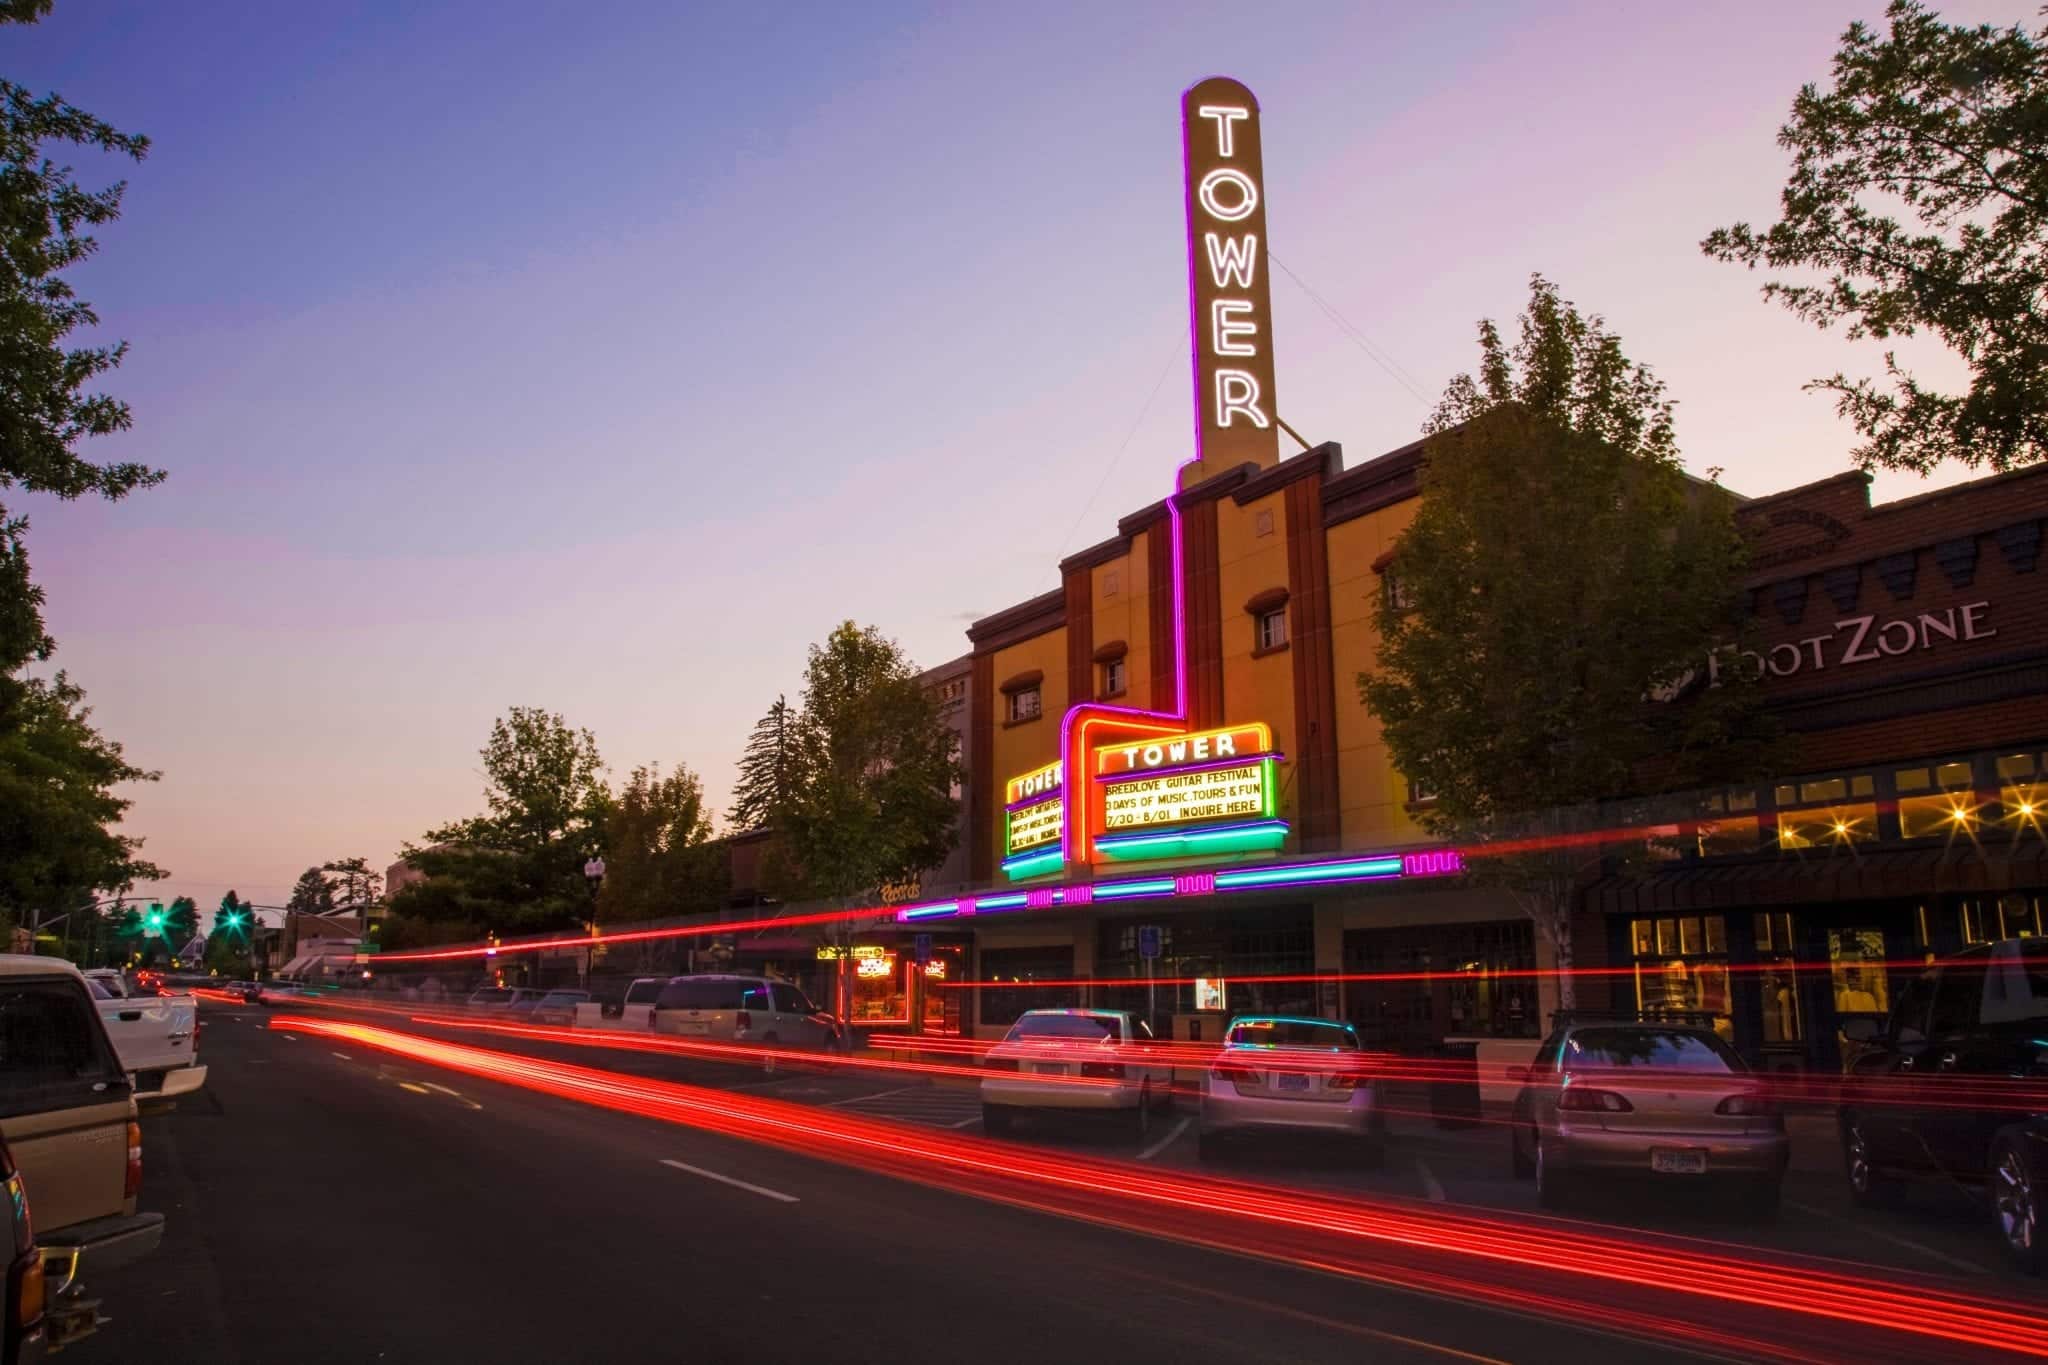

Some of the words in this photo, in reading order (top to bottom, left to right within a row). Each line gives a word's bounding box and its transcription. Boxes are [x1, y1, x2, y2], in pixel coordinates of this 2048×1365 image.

[1198, 105, 1270, 428] TOWER
[1122, 733, 1236, 769] TOWER
[1106, 780, 1160, 796] BREEDLOVE
[1167, 775, 1202, 788] GUITAR
[1208, 767, 1256, 783] FESTIVAL
[1113, 799, 1137, 810] DAYS
[1141, 796, 1153, 807] OF
[1230, 785, 1237, 796] &
[1239, 783, 1260, 796] FUN
[1107, 813, 1134, 827] 7/30
[1180, 803, 1223, 819] INQUIRE
[1227, 799, 1256, 813] HERE
